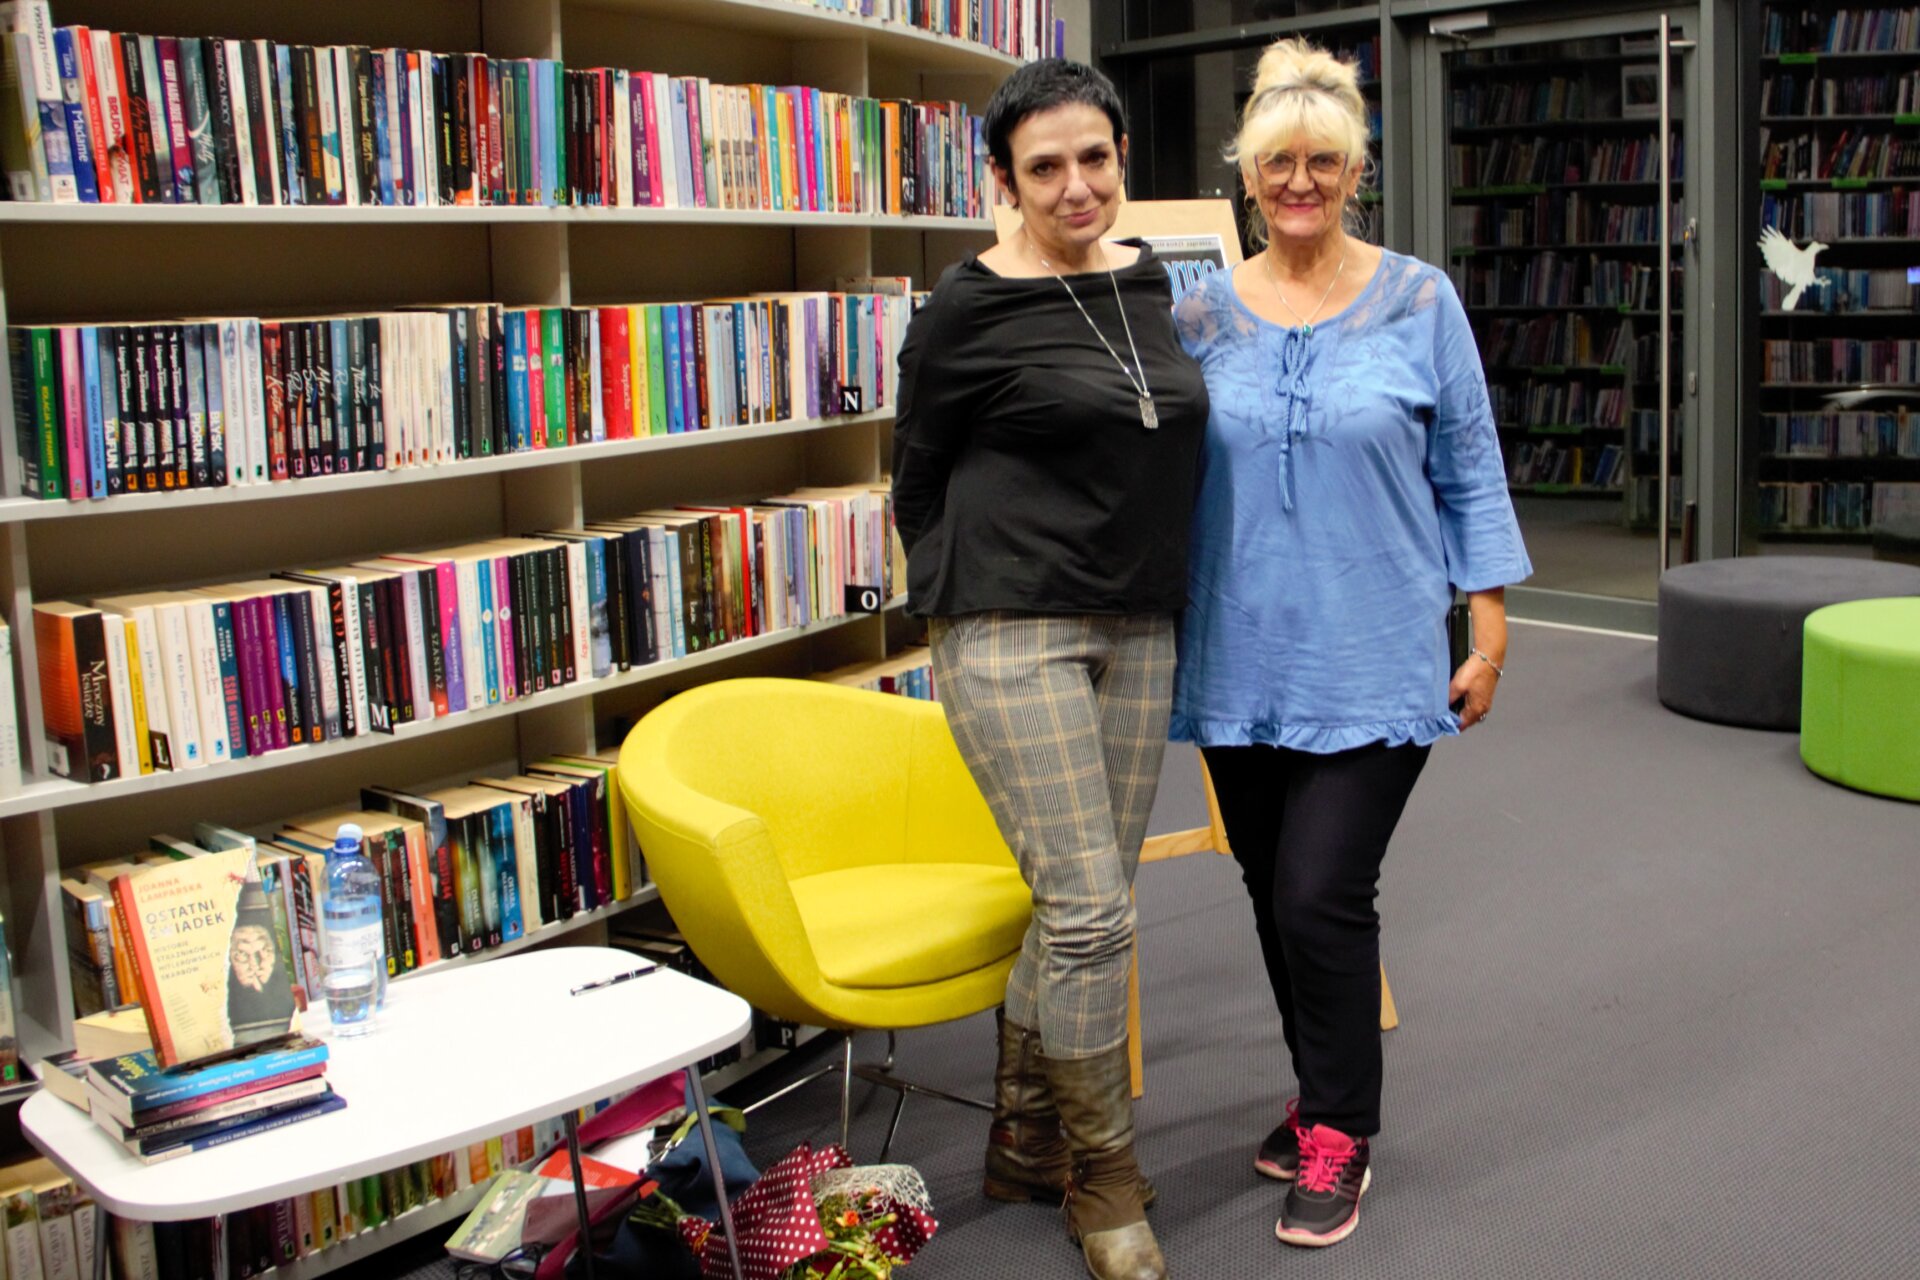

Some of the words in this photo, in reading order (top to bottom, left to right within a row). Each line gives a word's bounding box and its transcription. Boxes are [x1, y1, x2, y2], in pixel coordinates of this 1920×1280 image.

[72, 110, 88, 162] Madame
[843, 391, 859, 411] N
[104, 419, 119, 469] TAJFUN
[190, 412, 204, 463] PIORUN
[332, 588, 345, 637] CENA
[861, 590, 878, 611] O
[432, 632, 444, 689] SZANTAŻ
[81, 672, 94, 718] książę
[90, 660, 108, 726] Mroczny
[224, 676, 237, 702] BOSS
[319, 658, 338, 710] ARMIN
[343, 678, 354, 730] Waldemar
[228, 704, 242, 749] CASSIANO
[370, 703, 390, 730] M
[138, 877, 181, 894] JOANNA
[141, 882, 204, 904] LAMPARSKA
[146, 899, 216, 926] OSTATNI
[148, 912, 226, 940] ŚWIADEK
[780, 1028, 793, 1046] P
[48, 1223, 60, 1276] KRAWCZYK
[80, 1210, 92, 1262] KRAWCZYK
